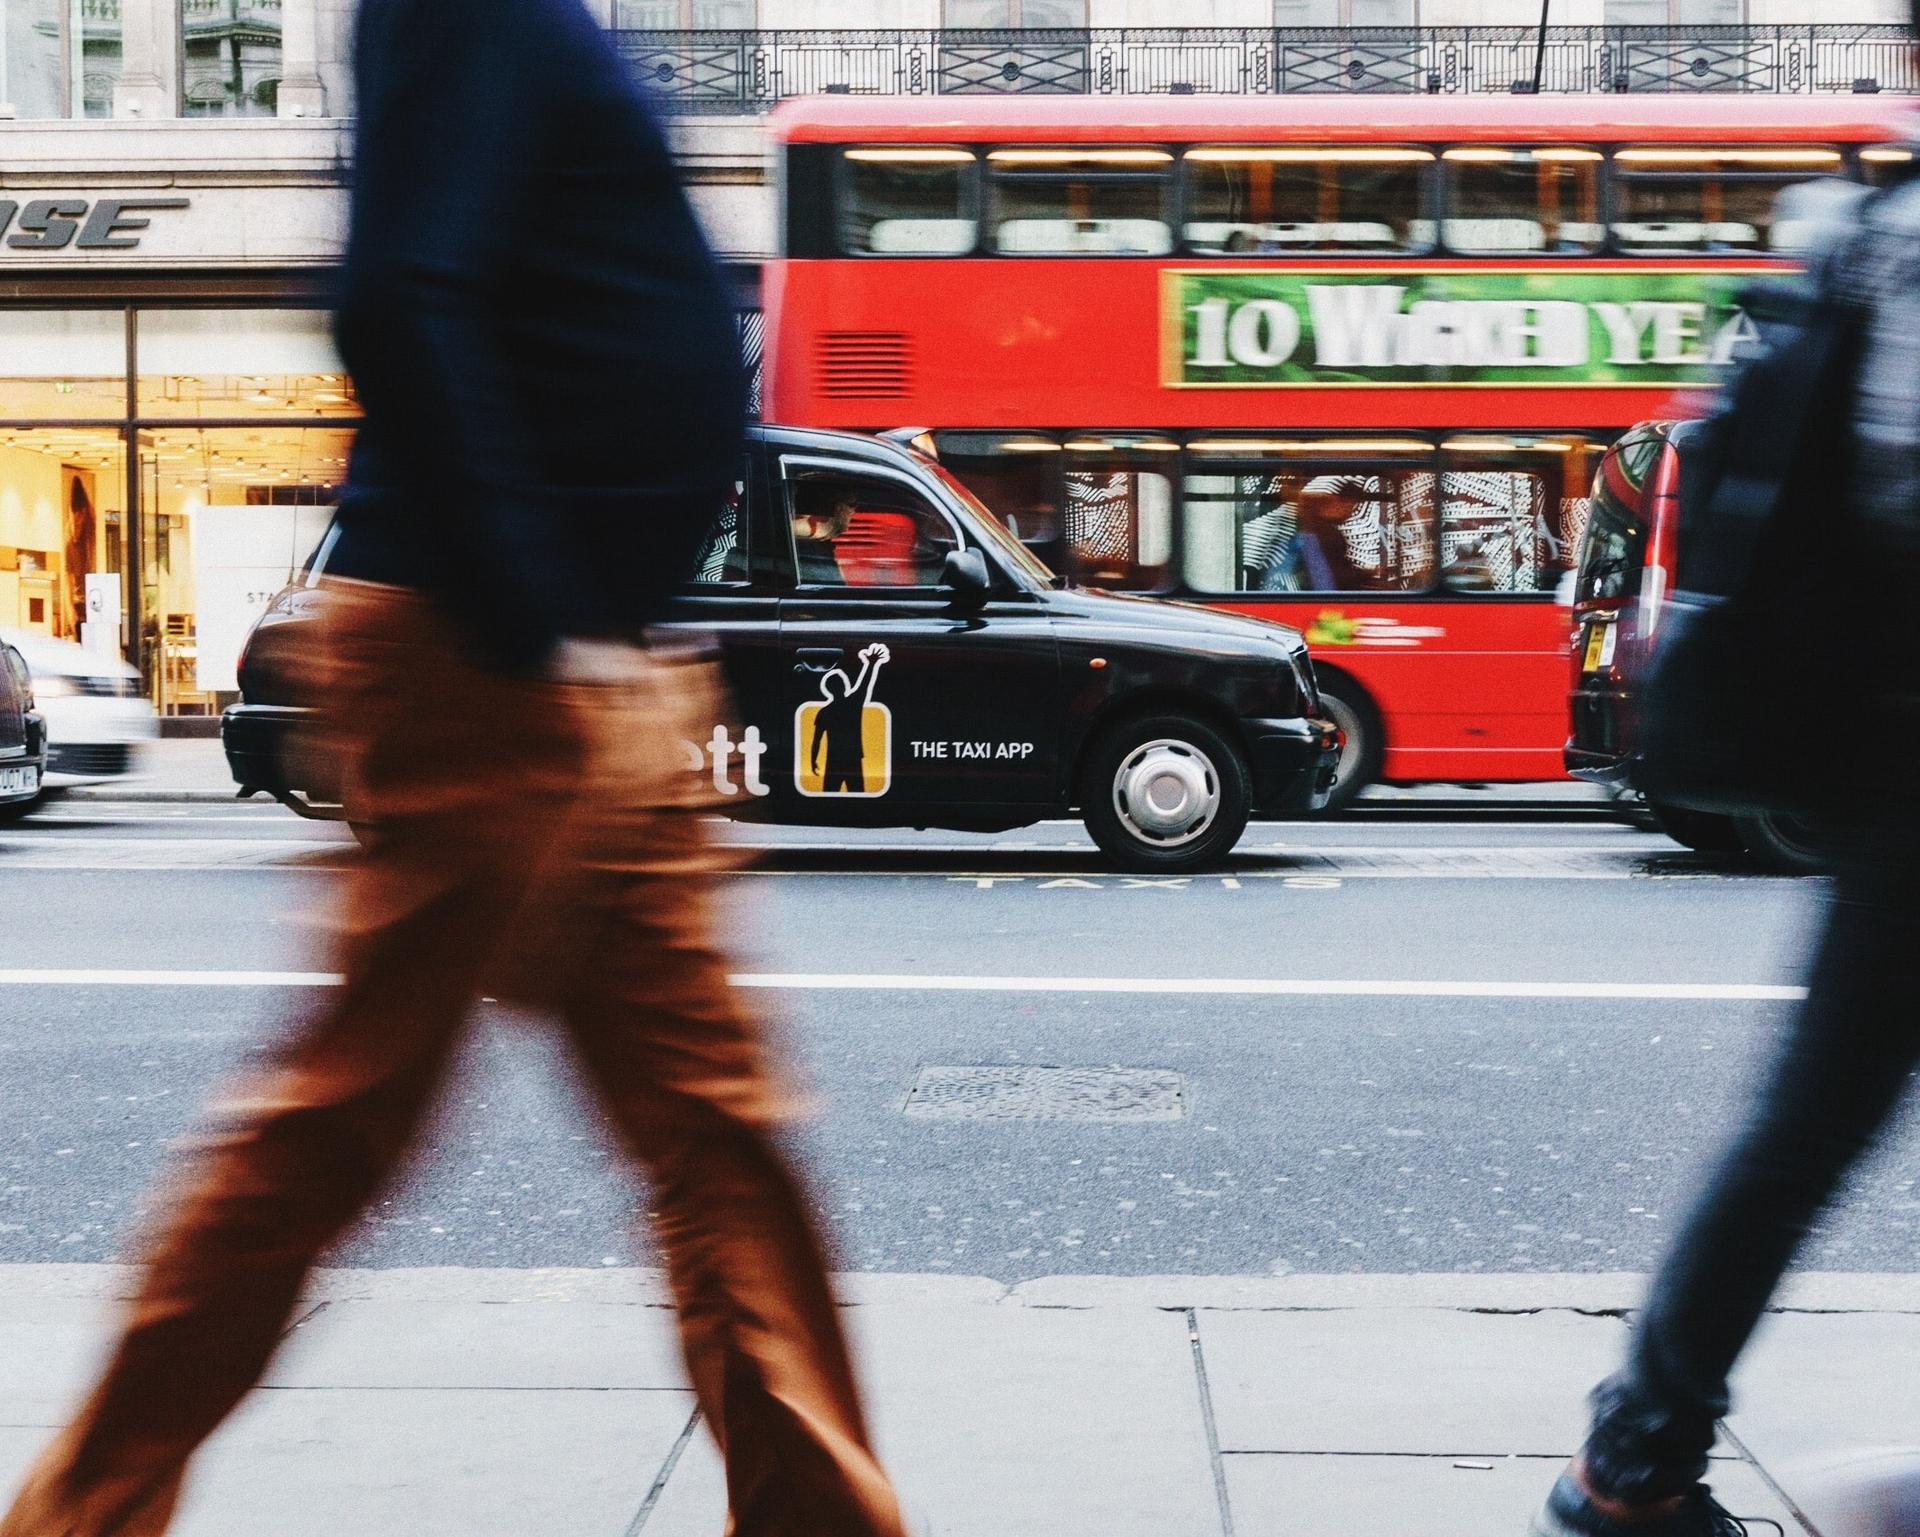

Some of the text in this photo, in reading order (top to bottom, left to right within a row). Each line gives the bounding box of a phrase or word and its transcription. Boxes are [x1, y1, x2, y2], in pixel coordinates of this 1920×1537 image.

[0, 199, 190, 250] SE
[1184, 298, 1300, 367] 10
[910, 741, 1034, 759] THE TAXI APP
[946, 876, 1342, 889] TAXIS
